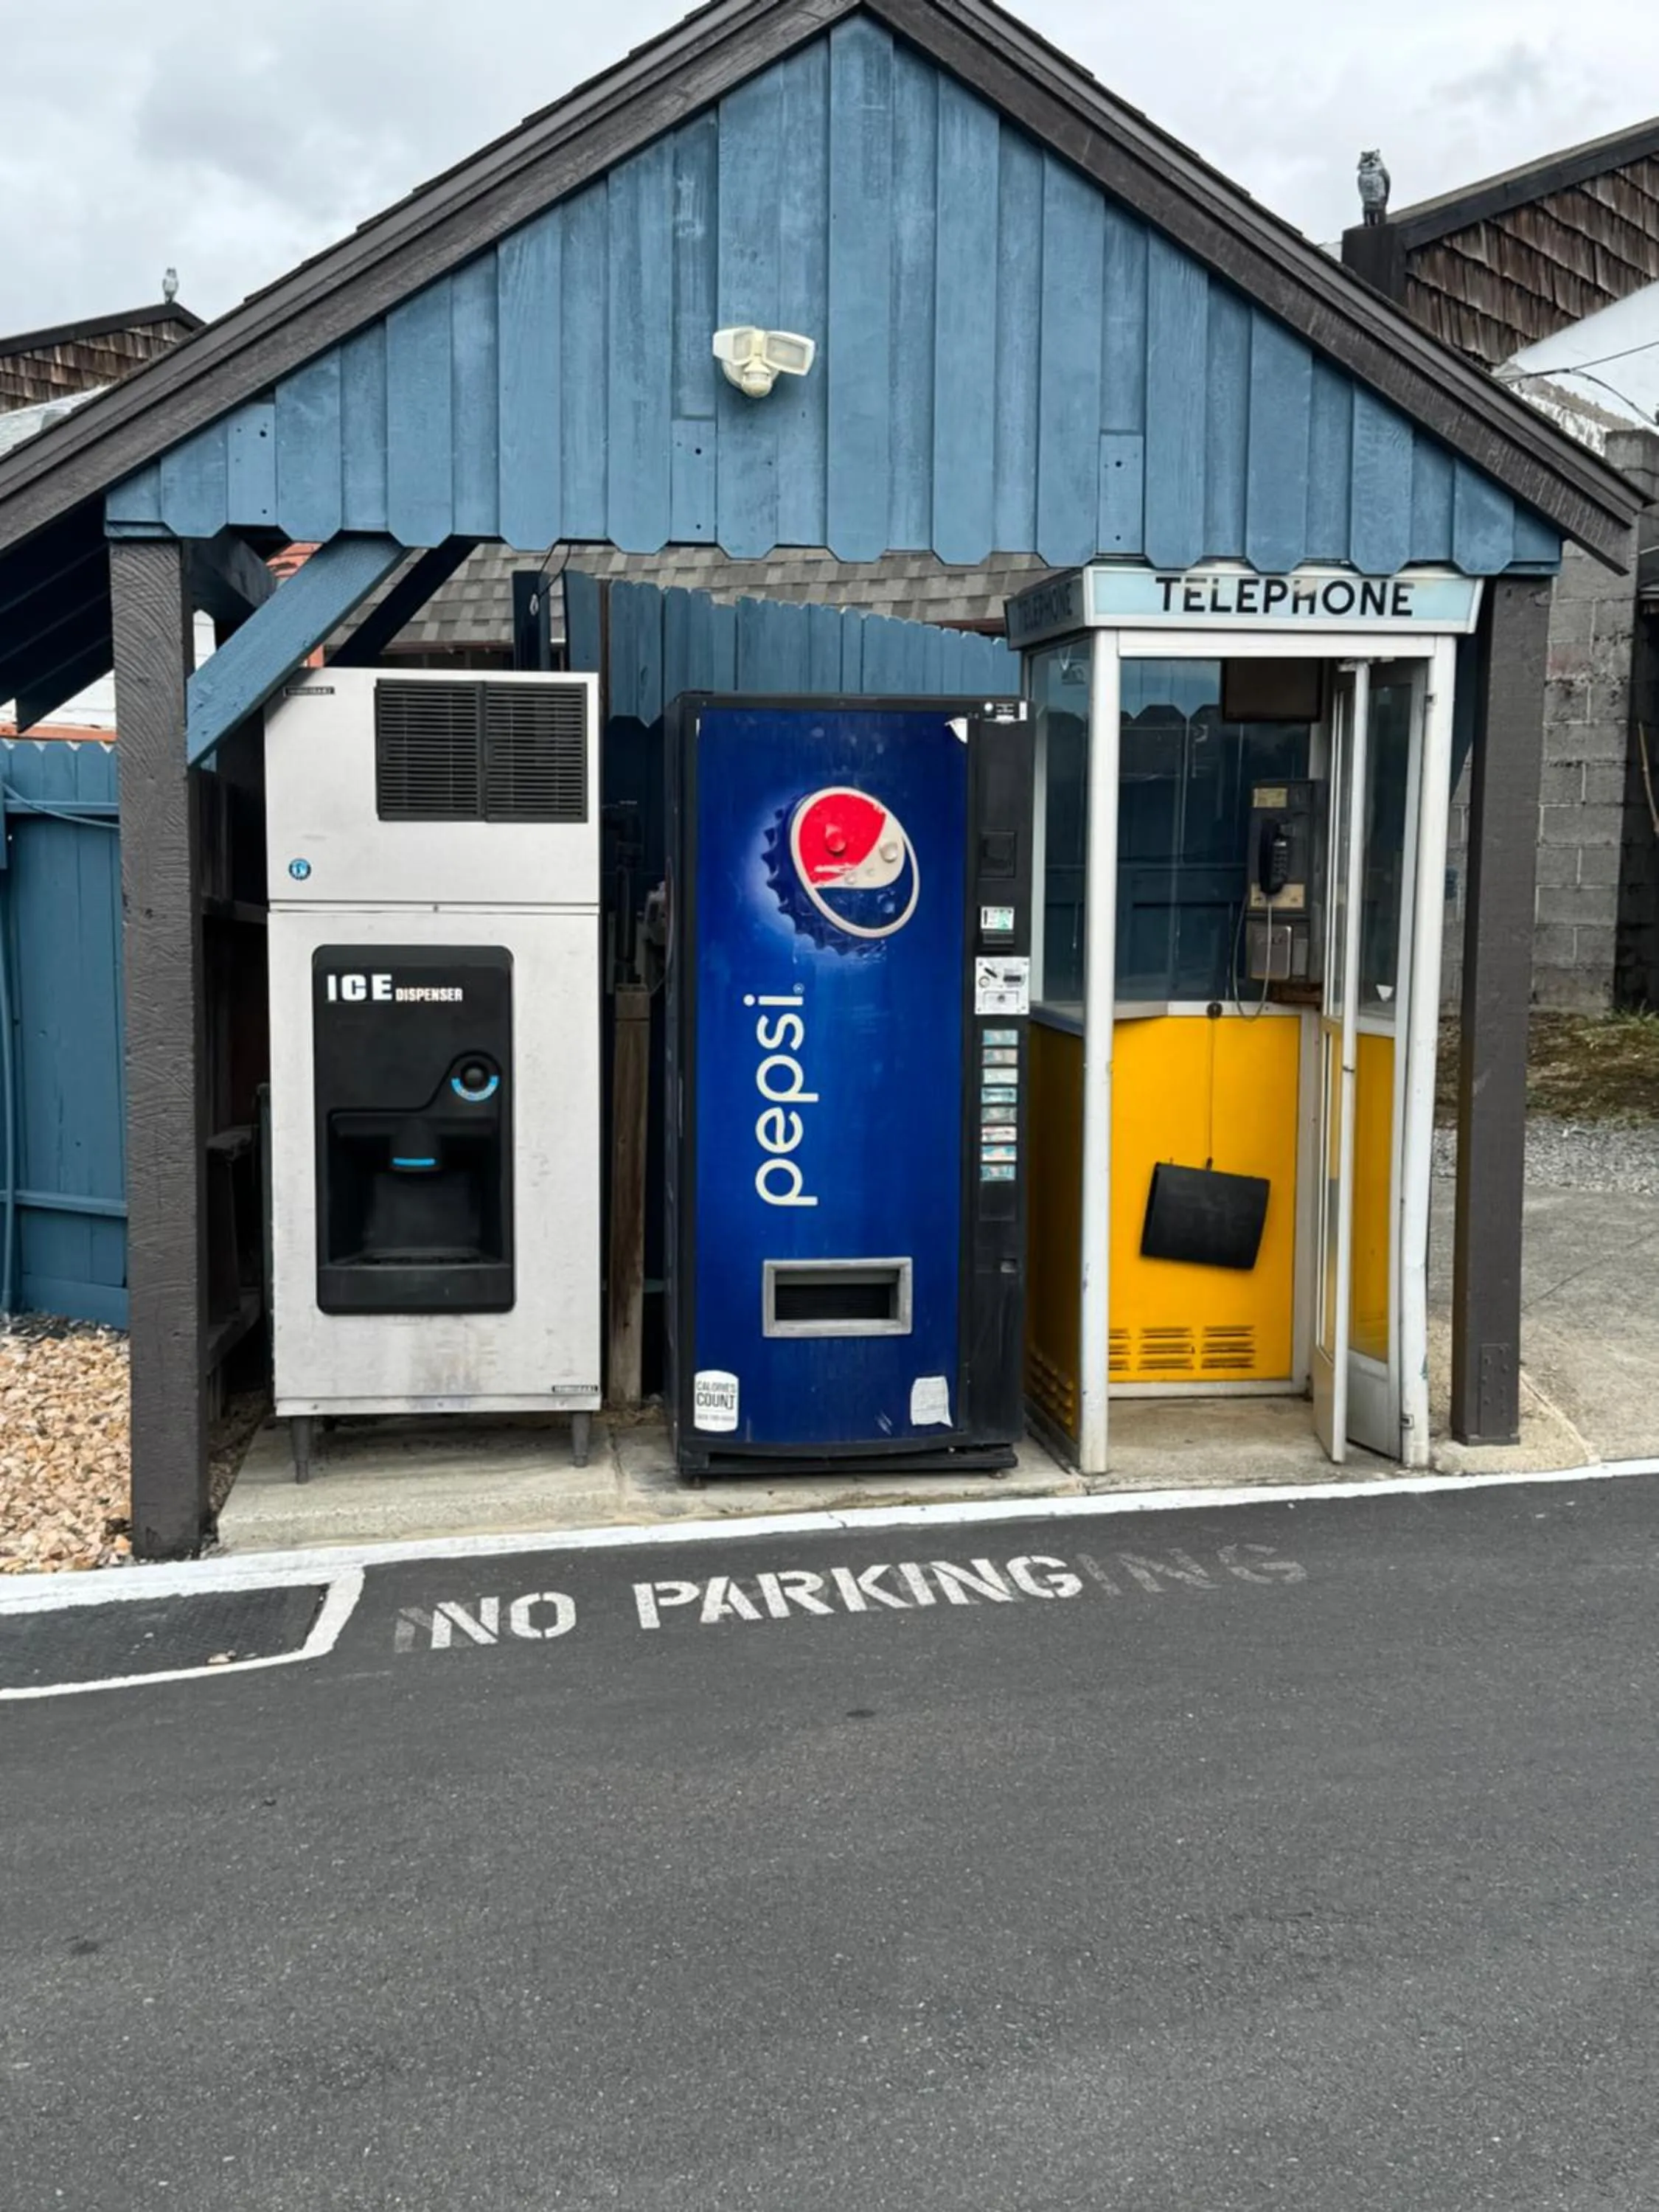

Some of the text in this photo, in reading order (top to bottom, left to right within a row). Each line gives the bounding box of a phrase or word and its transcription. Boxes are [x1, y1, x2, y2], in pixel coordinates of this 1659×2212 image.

[1155, 576, 1415, 616] TELEPHONE
[327, 973, 464, 1002] ICE DISPENSER
[743, 994, 819, 1206] pepsi
[696, 1391, 735, 1411] COUNT
[430, 1555, 1083, 1649] NO PARKING
